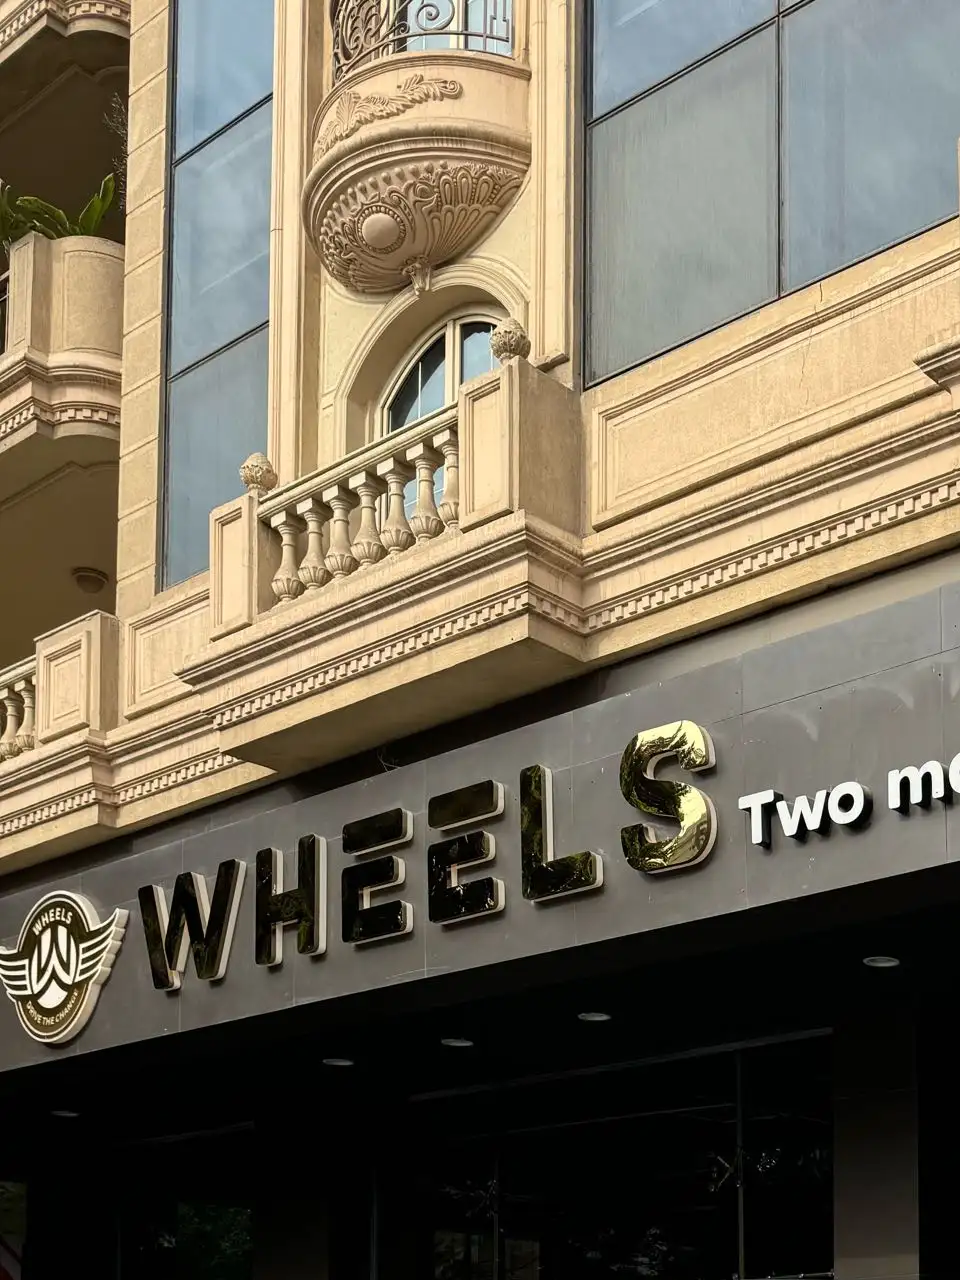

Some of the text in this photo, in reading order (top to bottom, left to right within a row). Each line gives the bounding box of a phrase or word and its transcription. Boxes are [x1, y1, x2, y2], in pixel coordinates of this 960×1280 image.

[738, 781, 866, 846] Two
[138, 720, 717, 992] WHEELS
[32, 907, 73, 936] WHEELS
[26, 1000, 42, 1024] DRIVE
[42, 1016, 55, 1026] THE
